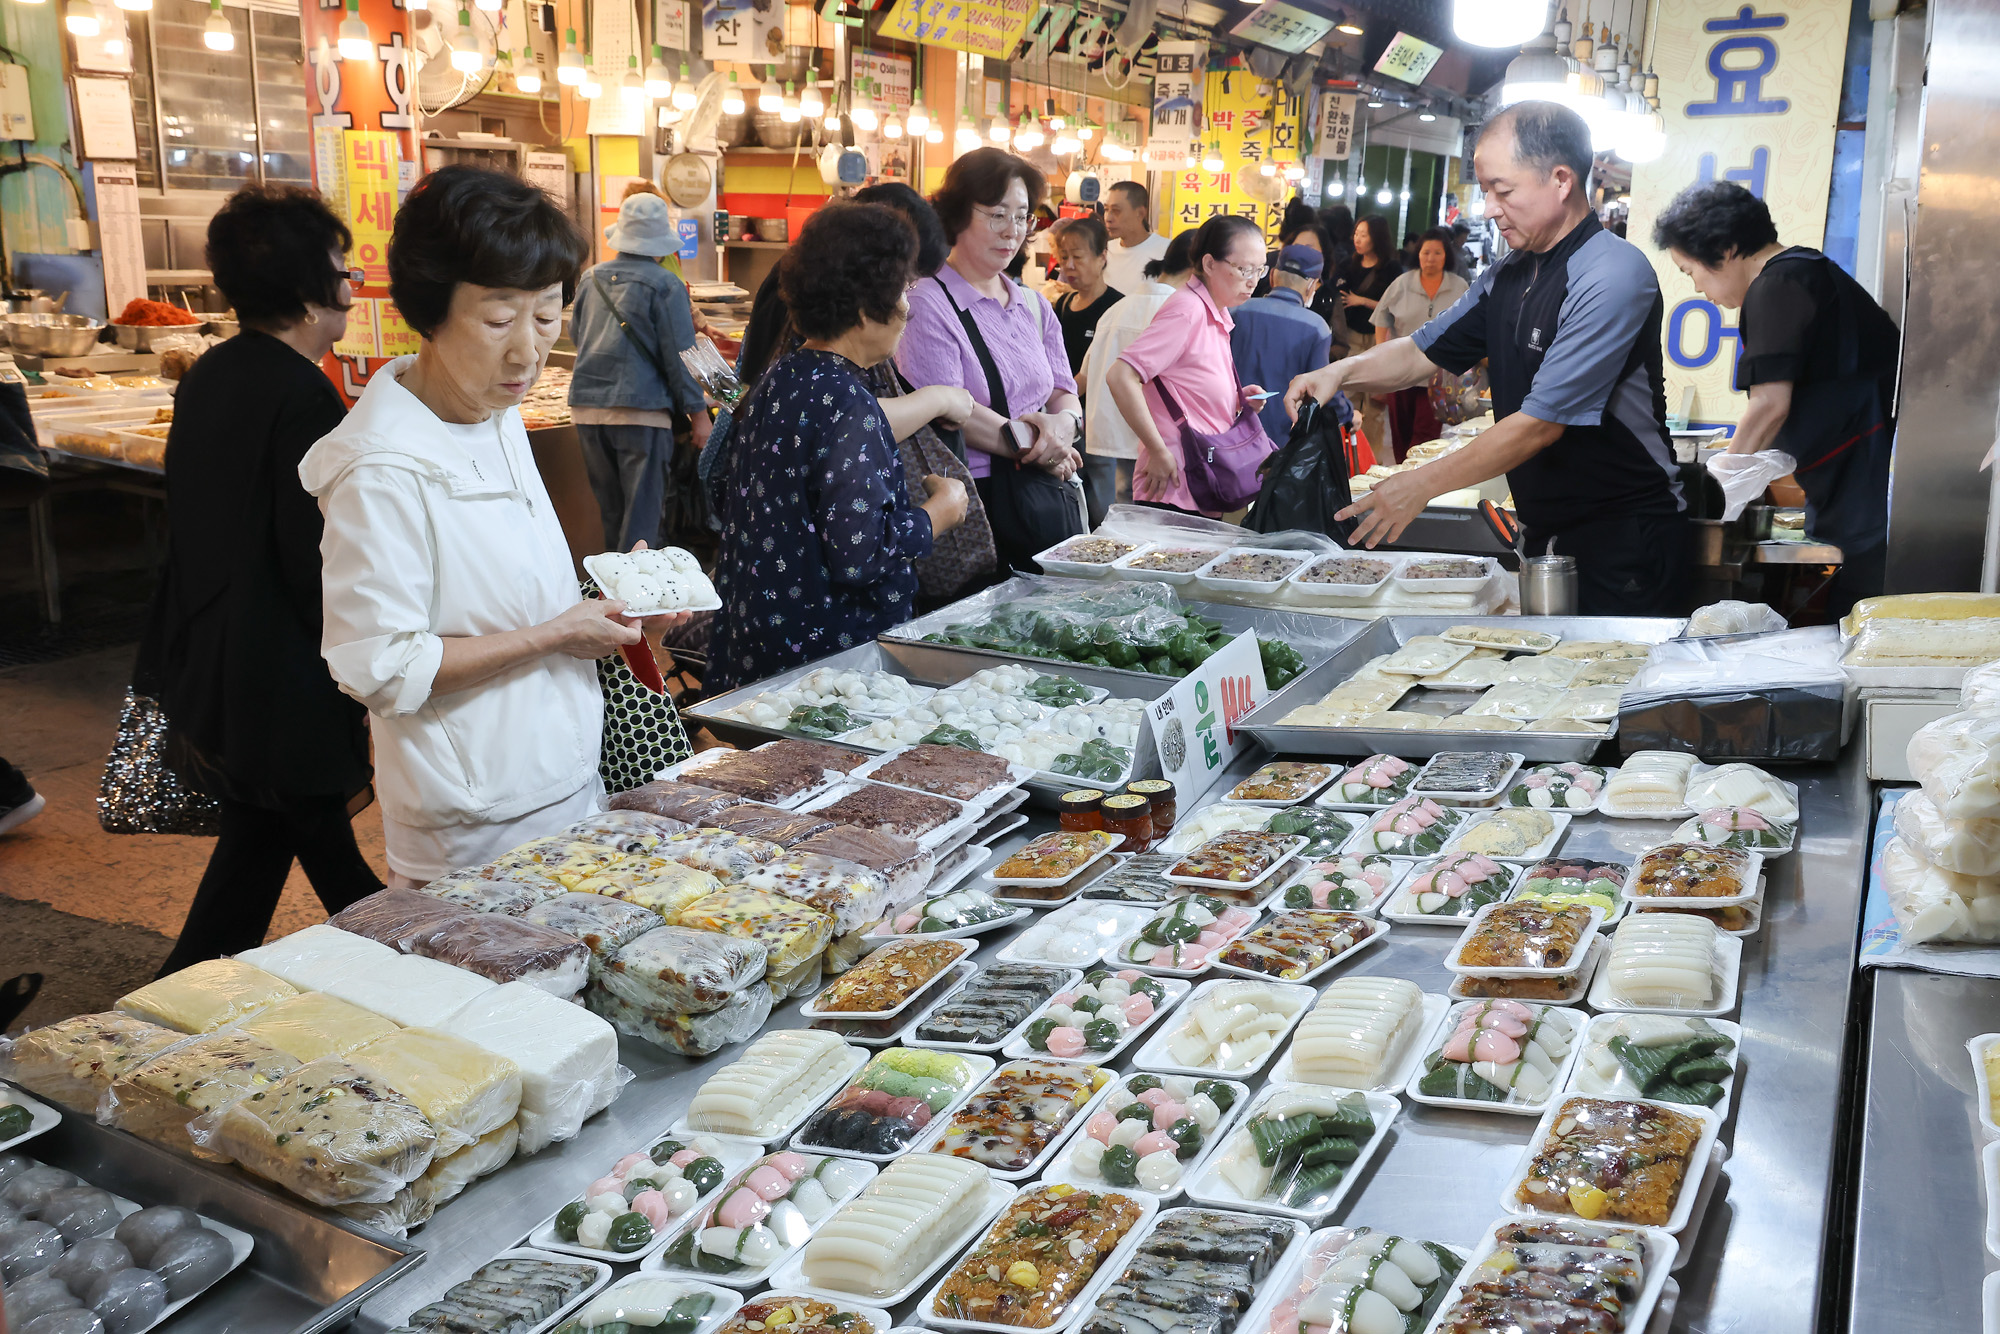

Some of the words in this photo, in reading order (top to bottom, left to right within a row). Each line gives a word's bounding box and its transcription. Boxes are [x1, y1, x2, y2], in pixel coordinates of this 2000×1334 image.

[715, 0, 741, 46] 찬
[1160, 56, 1190, 71] 대호
[1157, 109, 1187, 125] 찌개
[1325, 96, 1341, 139] 친환경
[1336, 111, 1351, 155] 농산물
[353, 139, 392, 282] 빅세일
